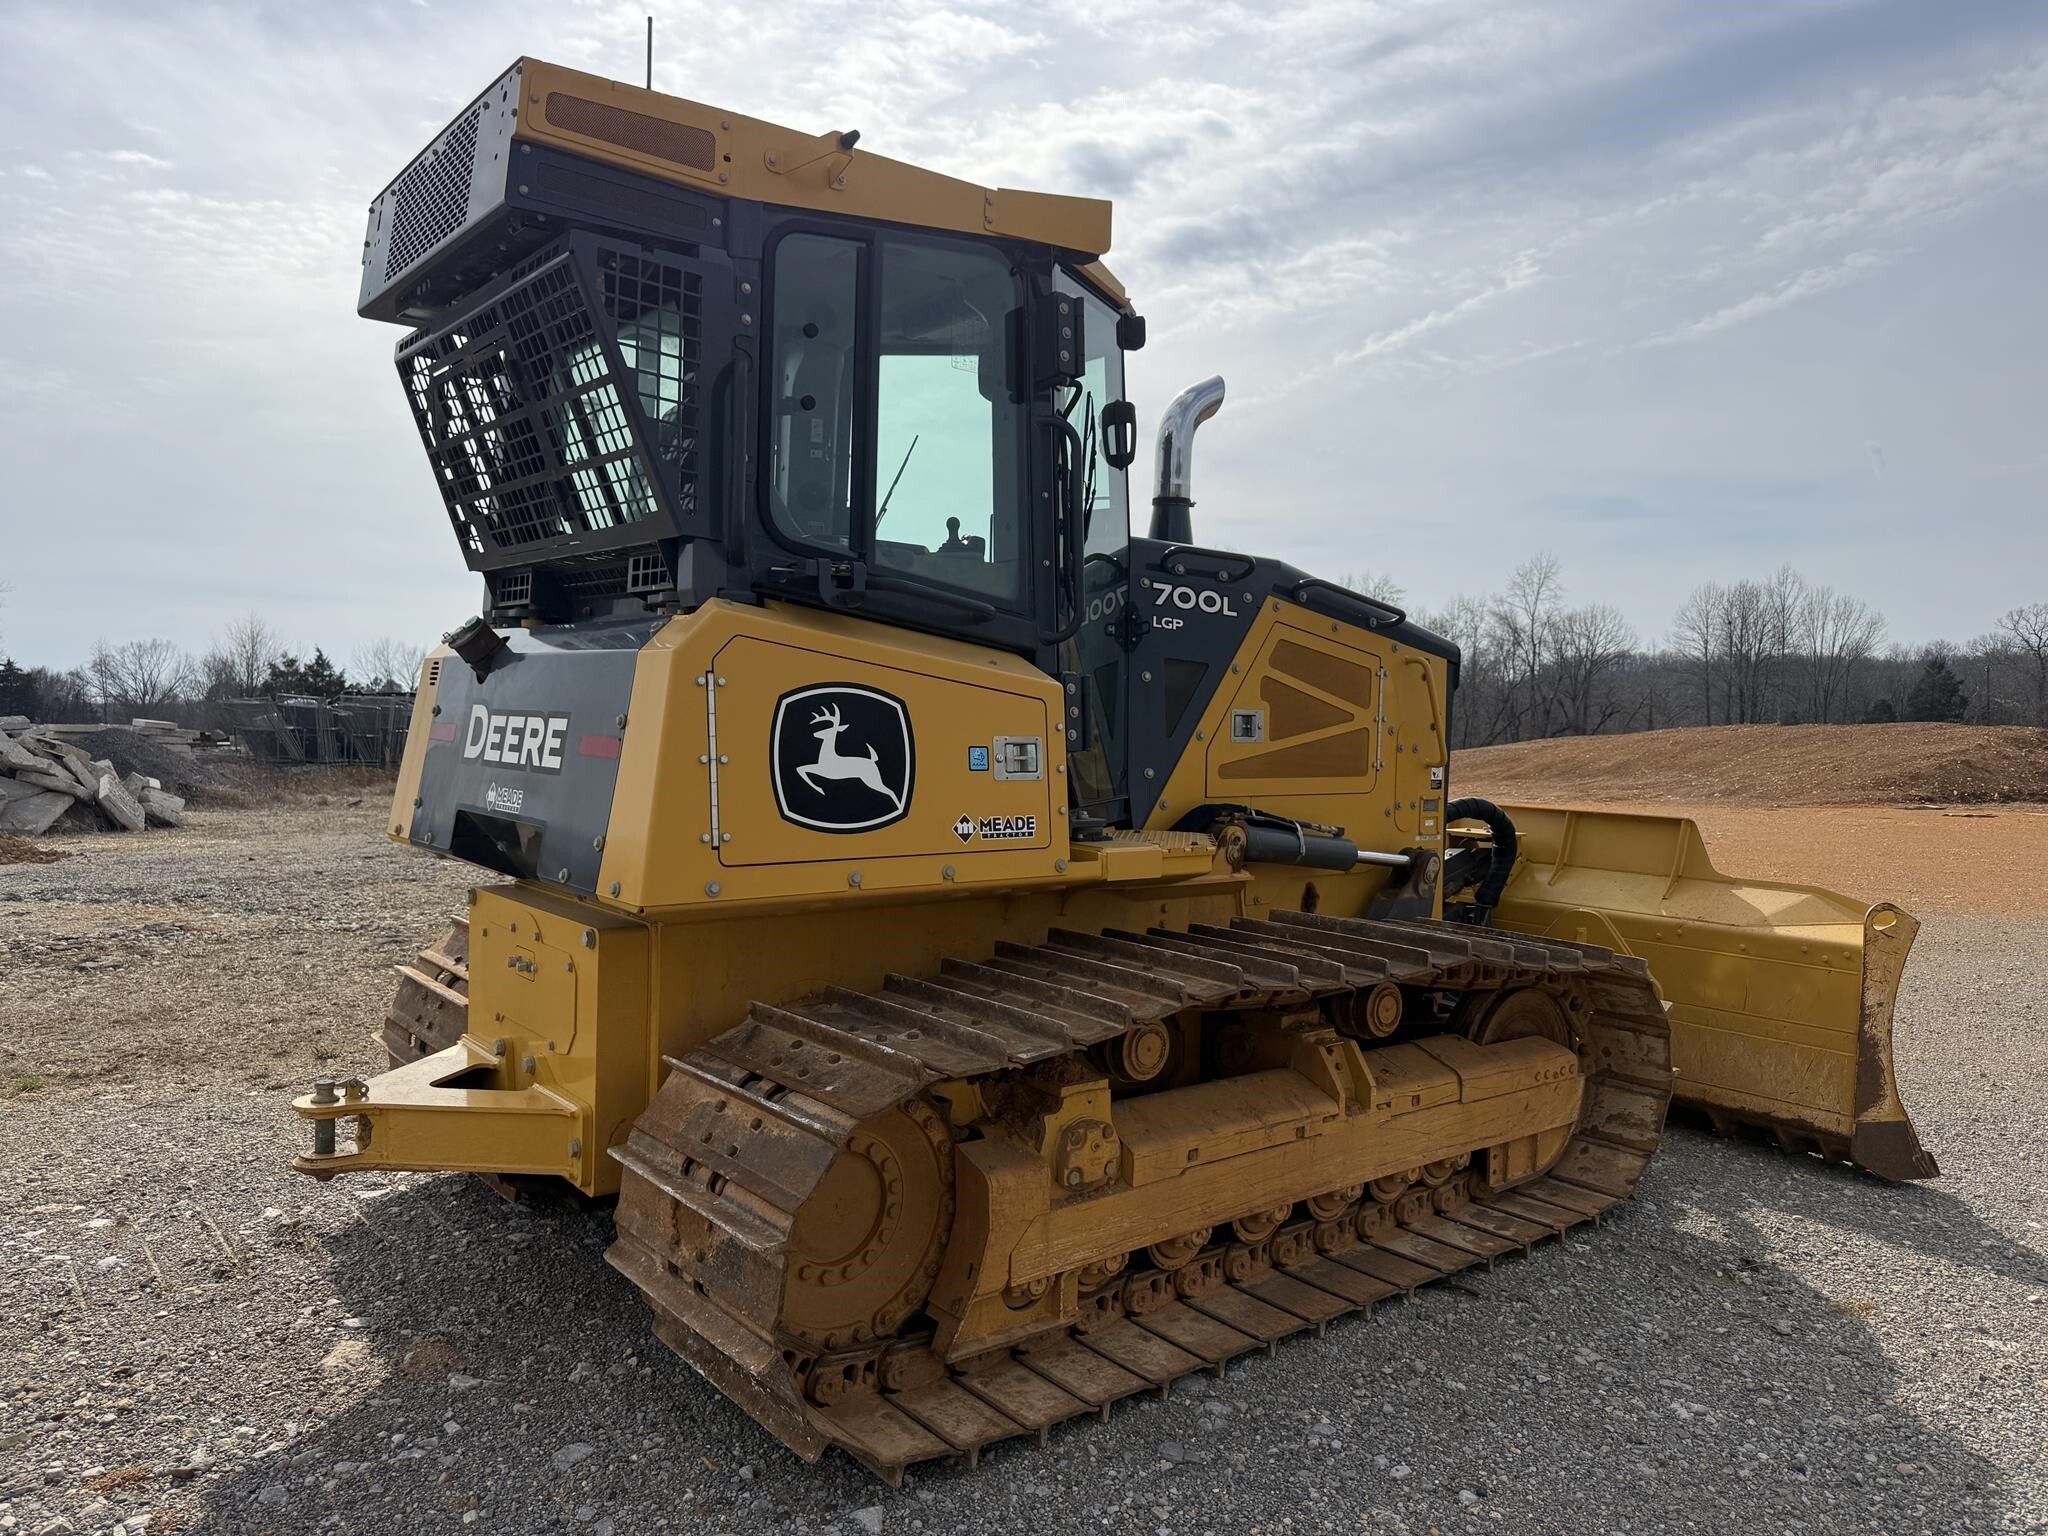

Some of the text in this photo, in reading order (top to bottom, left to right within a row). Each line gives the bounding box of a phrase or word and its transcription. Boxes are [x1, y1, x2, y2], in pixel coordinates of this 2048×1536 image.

[1153, 582, 1238, 617] 700L
[1153, 615, 1184, 631] LGP
[463, 703, 569, 769] DEERE
[980, 815, 1036, 833] MEADE
